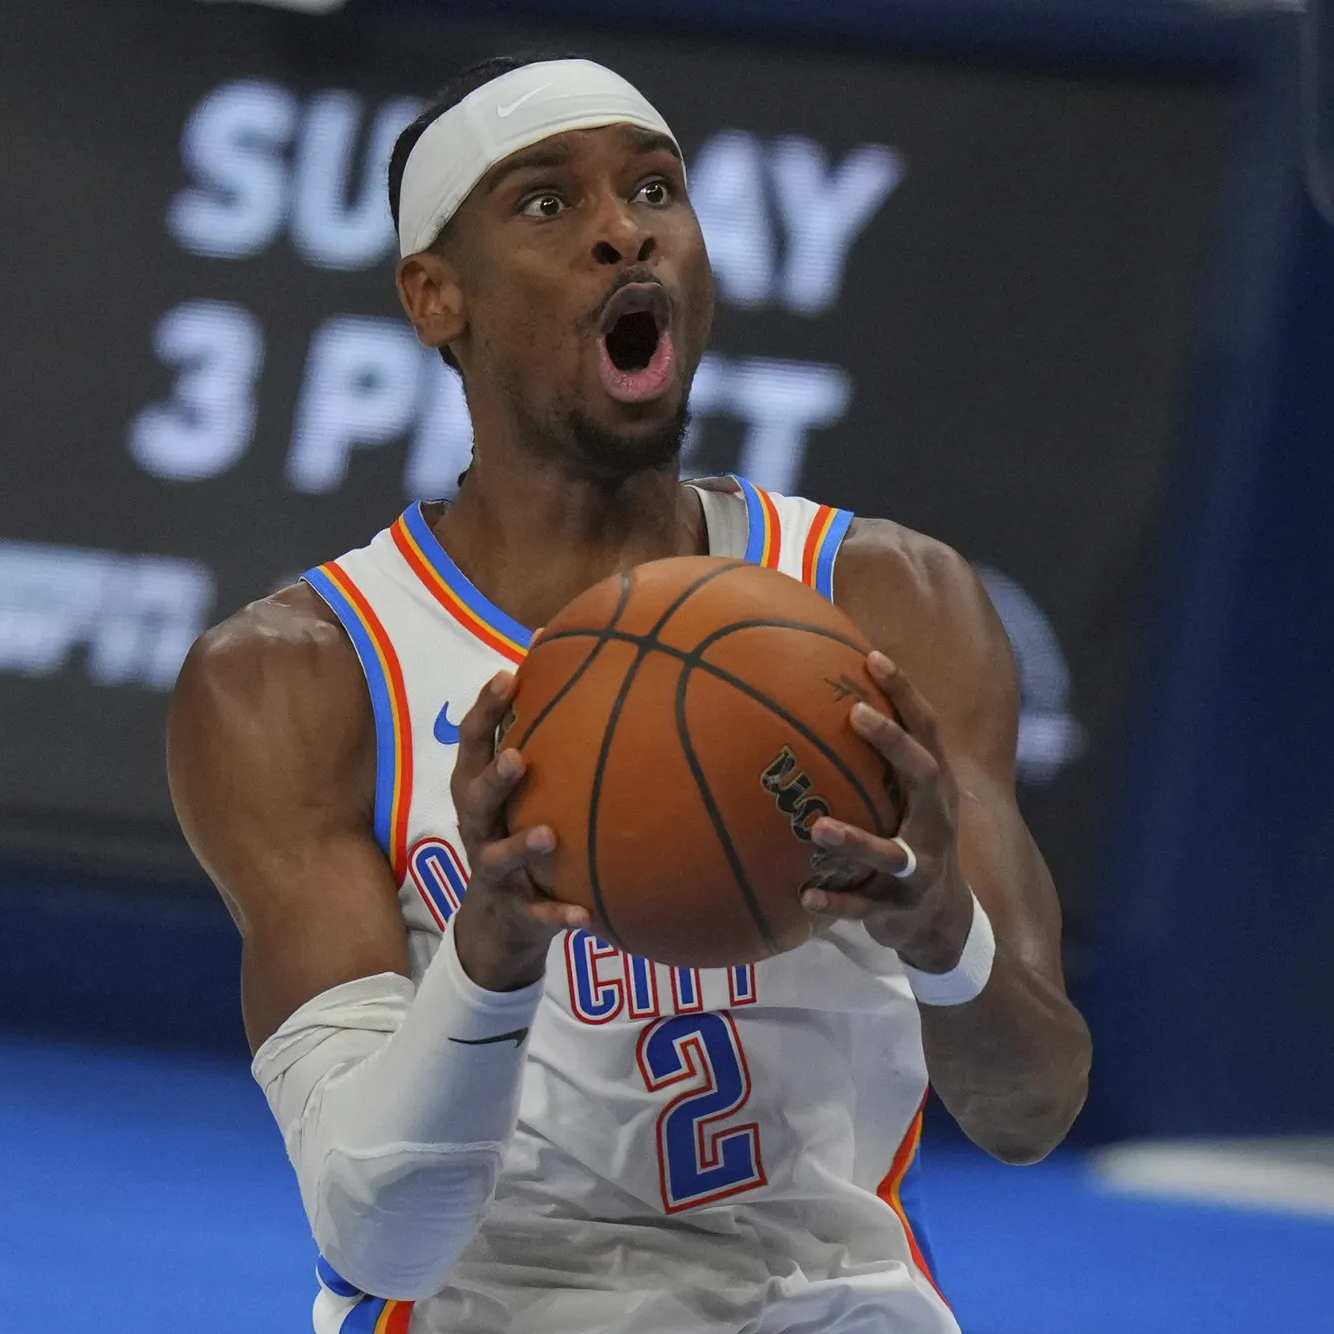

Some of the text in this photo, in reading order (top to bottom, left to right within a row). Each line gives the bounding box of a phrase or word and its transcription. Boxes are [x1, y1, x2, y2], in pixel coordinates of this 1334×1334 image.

[164, 80, 902, 316] SUAY
[127, 299, 264, 485] 3
[635, 1009, 768, 1216] 2
